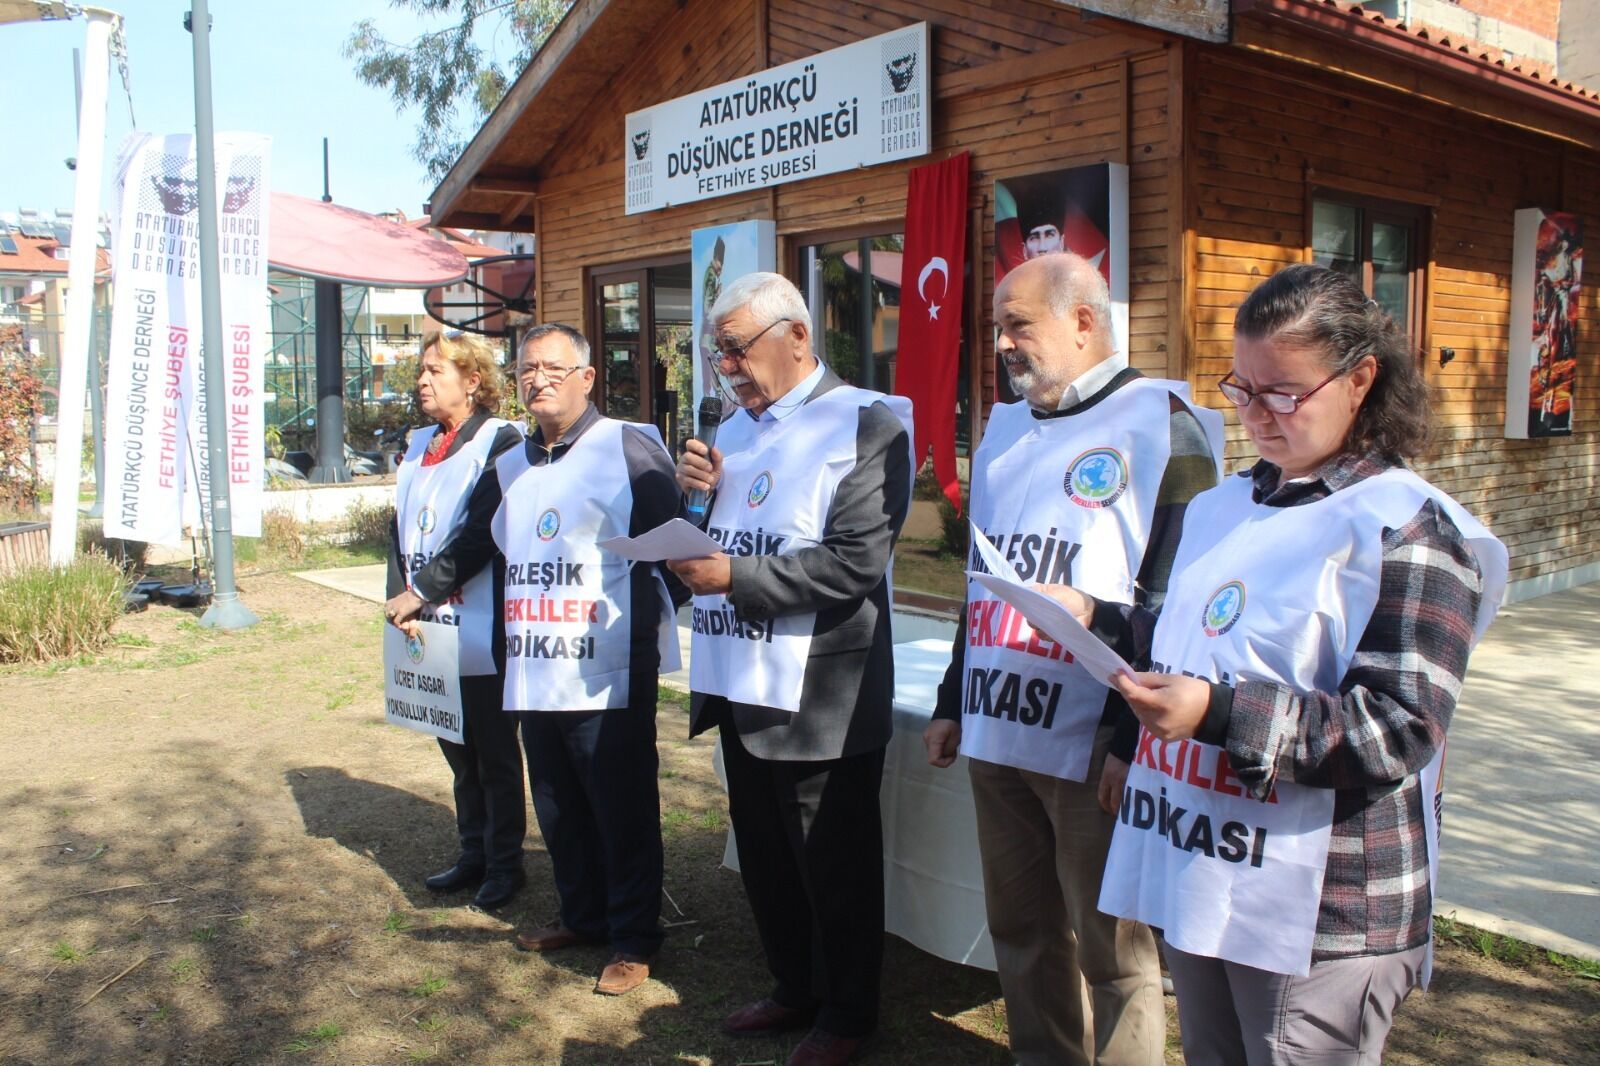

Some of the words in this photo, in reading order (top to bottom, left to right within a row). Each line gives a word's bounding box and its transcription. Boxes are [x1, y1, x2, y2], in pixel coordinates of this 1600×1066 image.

[700, 64, 817, 128] ATATÜRKÇÜ
[668, 135, 755, 178] DÜŞÜNCE
[762, 97, 858, 156] DERNEĞİ
[698, 167, 756, 194] FETHİYE
[761, 149, 816, 184] ŞUBESİ
[134, 289, 156, 358] DERNEĞİ
[165, 325, 189, 400] ŞUBESİ
[231, 324, 254, 398] ŞUBESİ
[127, 362, 150, 435] DÜŞÜNCE
[159, 405, 178, 489] FETHİYE
[228, 403, 249, 484] FETHİYE
[121, 438, 146, 529] ATATÜRKÇÜ
[393, 664, 416, 690] ÜCRET
[387, 697, 429, 723] YOKSULLUK
[429, 705, 460, 733] SÜREKLİ
